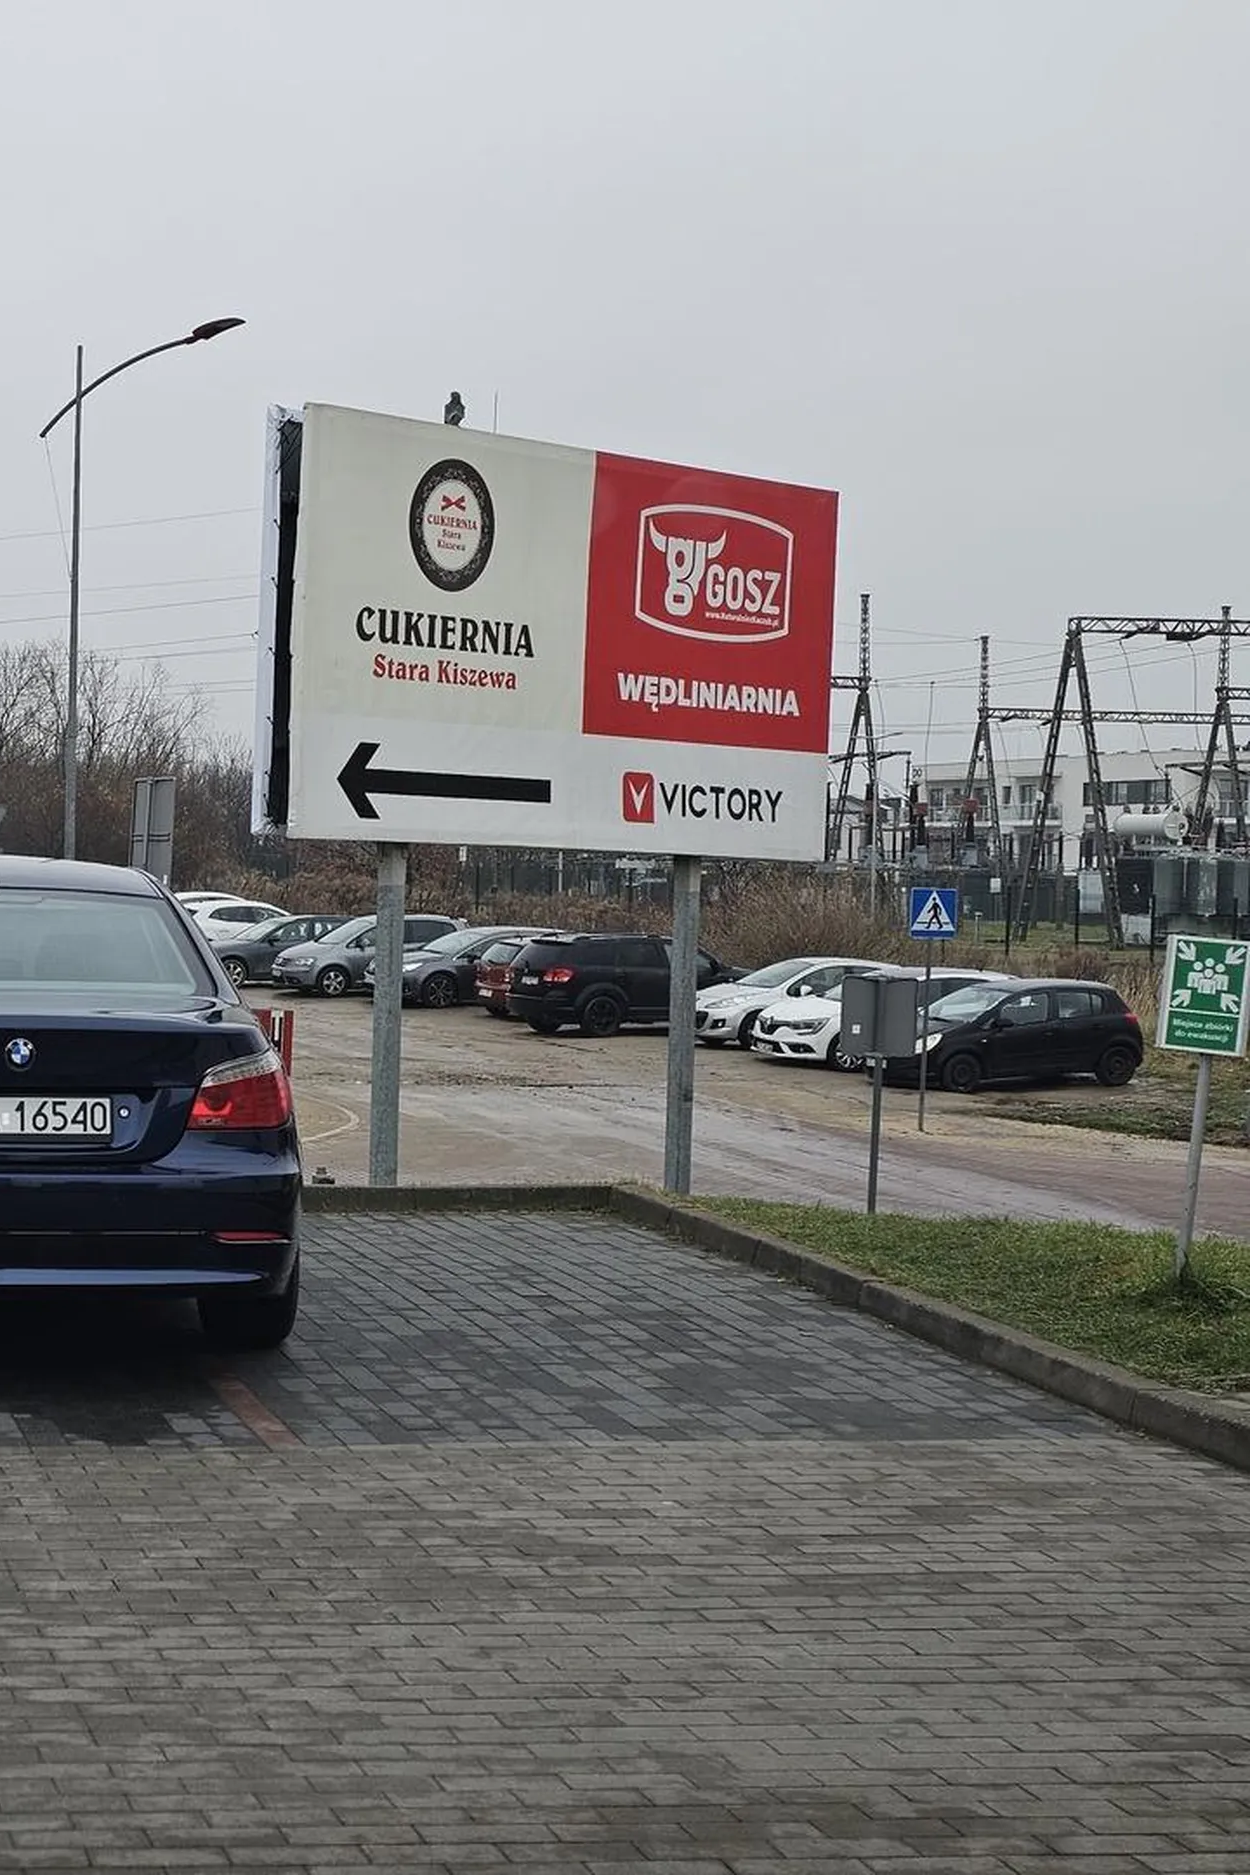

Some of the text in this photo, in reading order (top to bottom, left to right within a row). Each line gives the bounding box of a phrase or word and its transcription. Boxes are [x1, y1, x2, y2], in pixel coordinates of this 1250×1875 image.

[427, 513, 478, 531] CUKIERNIA
[706, 563, 782, 615] GOSZ
[355, 606, 535, 658] CUKIERNIA
[372, 652, 430, 683] Stara
[437, 659, 518, 690] Kiszewa
[617, 672, 800, 717] WĘDLINIARNIA
[659, 782, 784, 823] VICTORY
[14, 1100, 108, 1133] 16540
